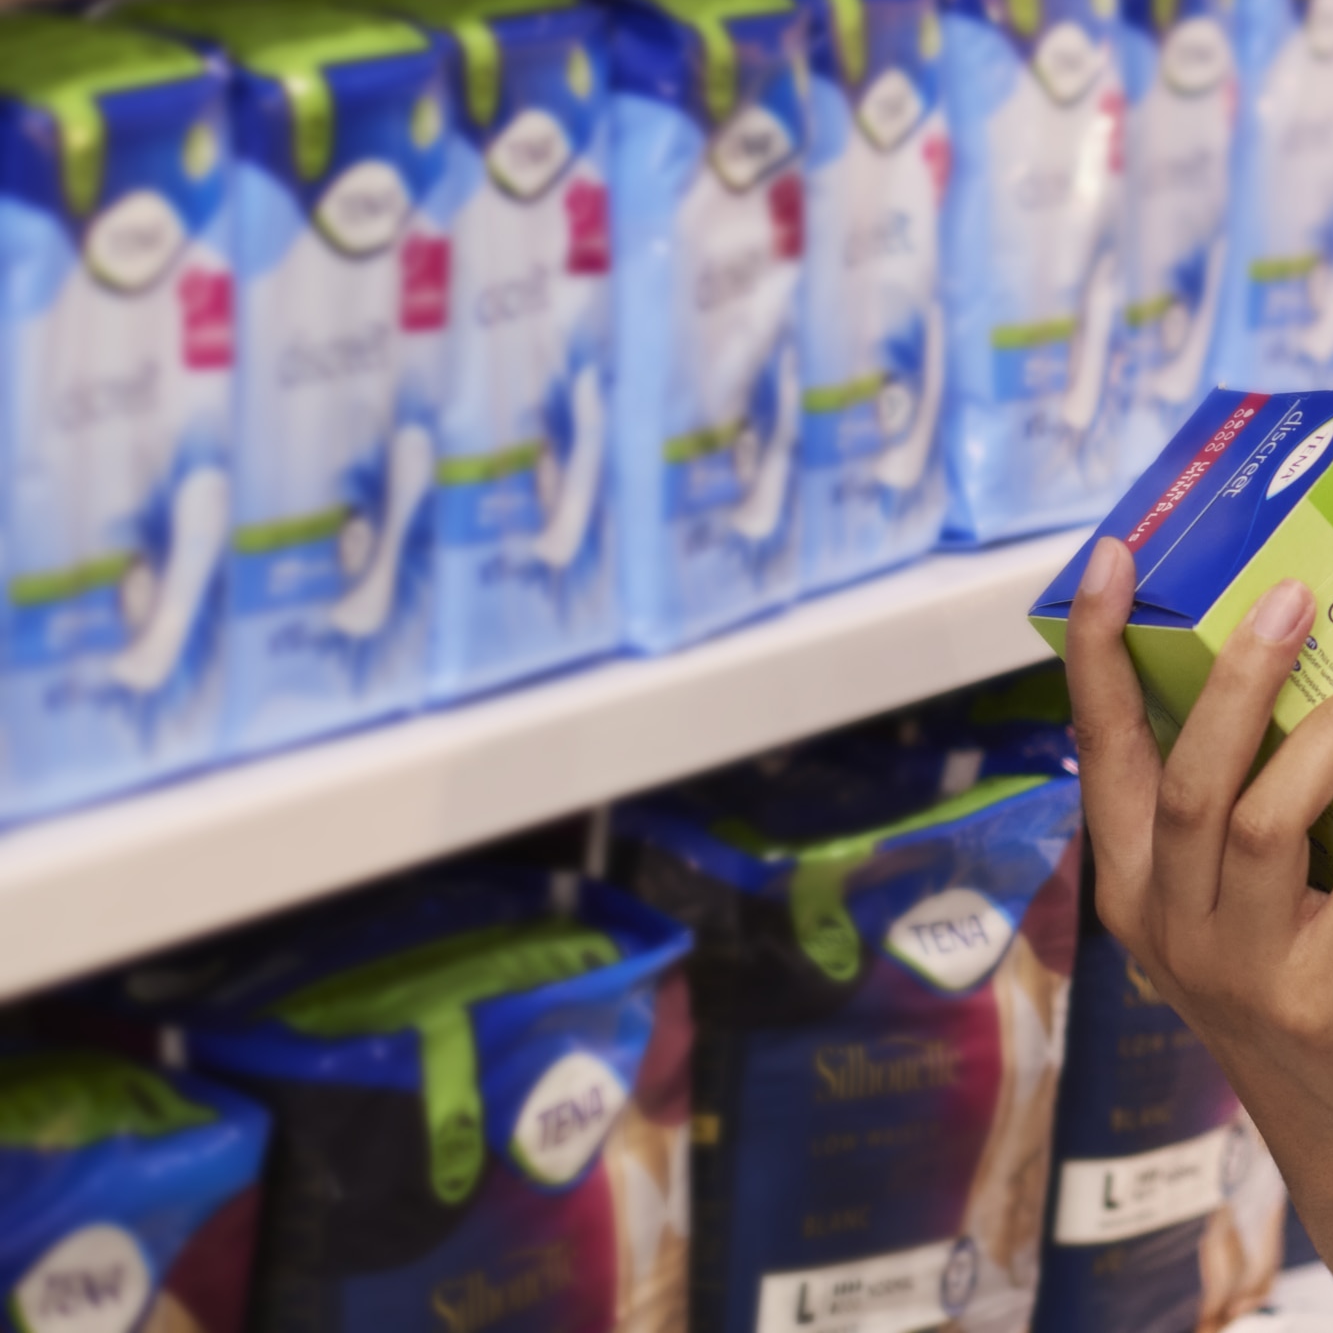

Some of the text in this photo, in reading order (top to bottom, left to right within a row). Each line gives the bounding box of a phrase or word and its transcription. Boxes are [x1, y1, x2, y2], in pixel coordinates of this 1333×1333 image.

[1222, 410, 1303, 498] discreet
[1281, 434, 1326, 481] TENA
[1128, 461, 1202, 542] MINI PLUS
[1161, 461, 1211, 512] ULTRA
[911, 914, 991, 957] TENA
[533, 1084, 607, 1152] TENA
[1103, 1170, 1119, 1211] L
[795, 1282, 814, 1325] L
